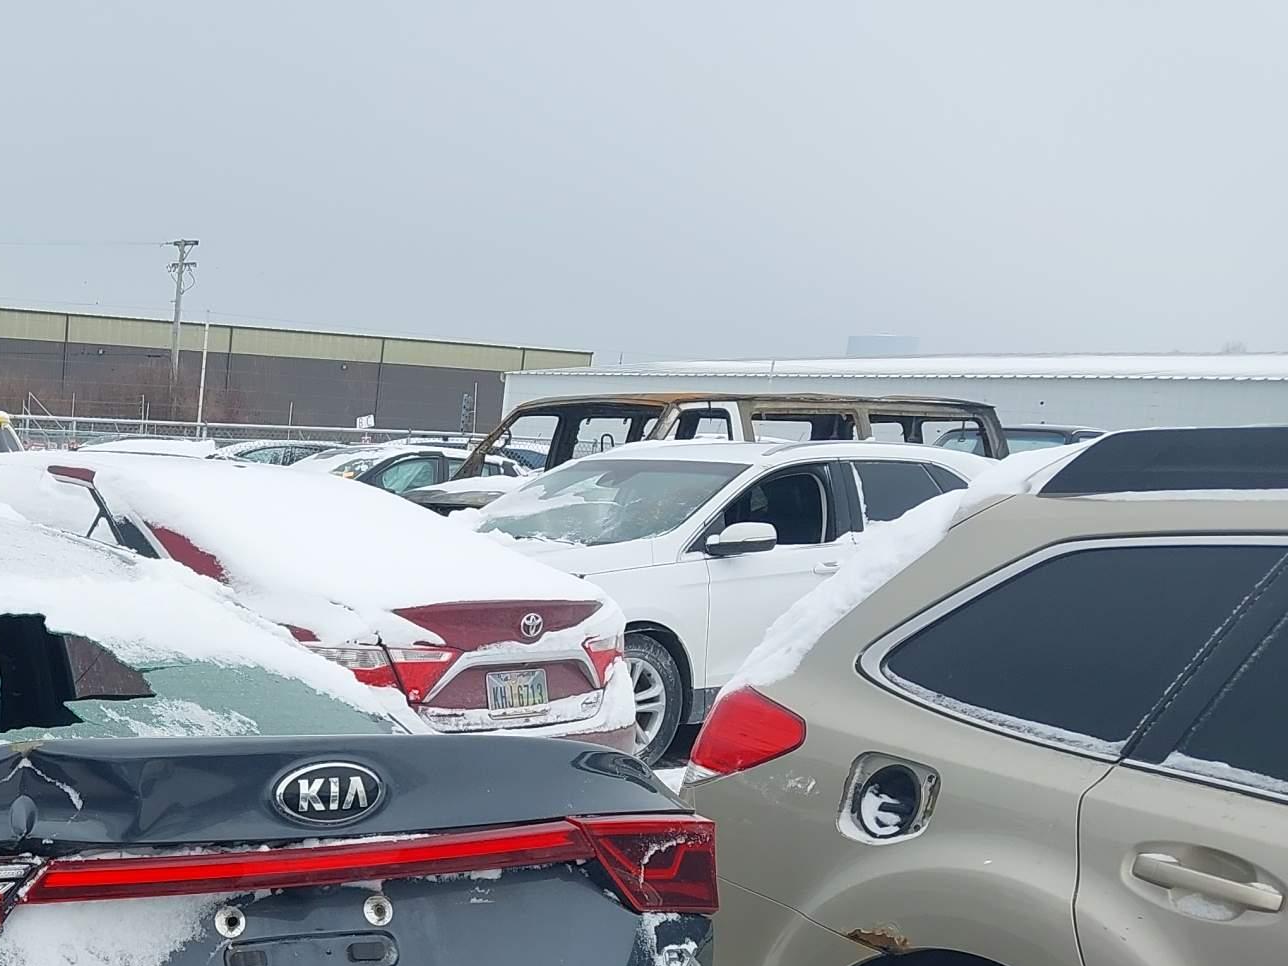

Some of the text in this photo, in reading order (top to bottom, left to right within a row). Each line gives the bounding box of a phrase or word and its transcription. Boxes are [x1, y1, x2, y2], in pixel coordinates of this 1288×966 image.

[493, 683, 544, 709] KHJ 6713
[298, 776, 368, 812] KIA
